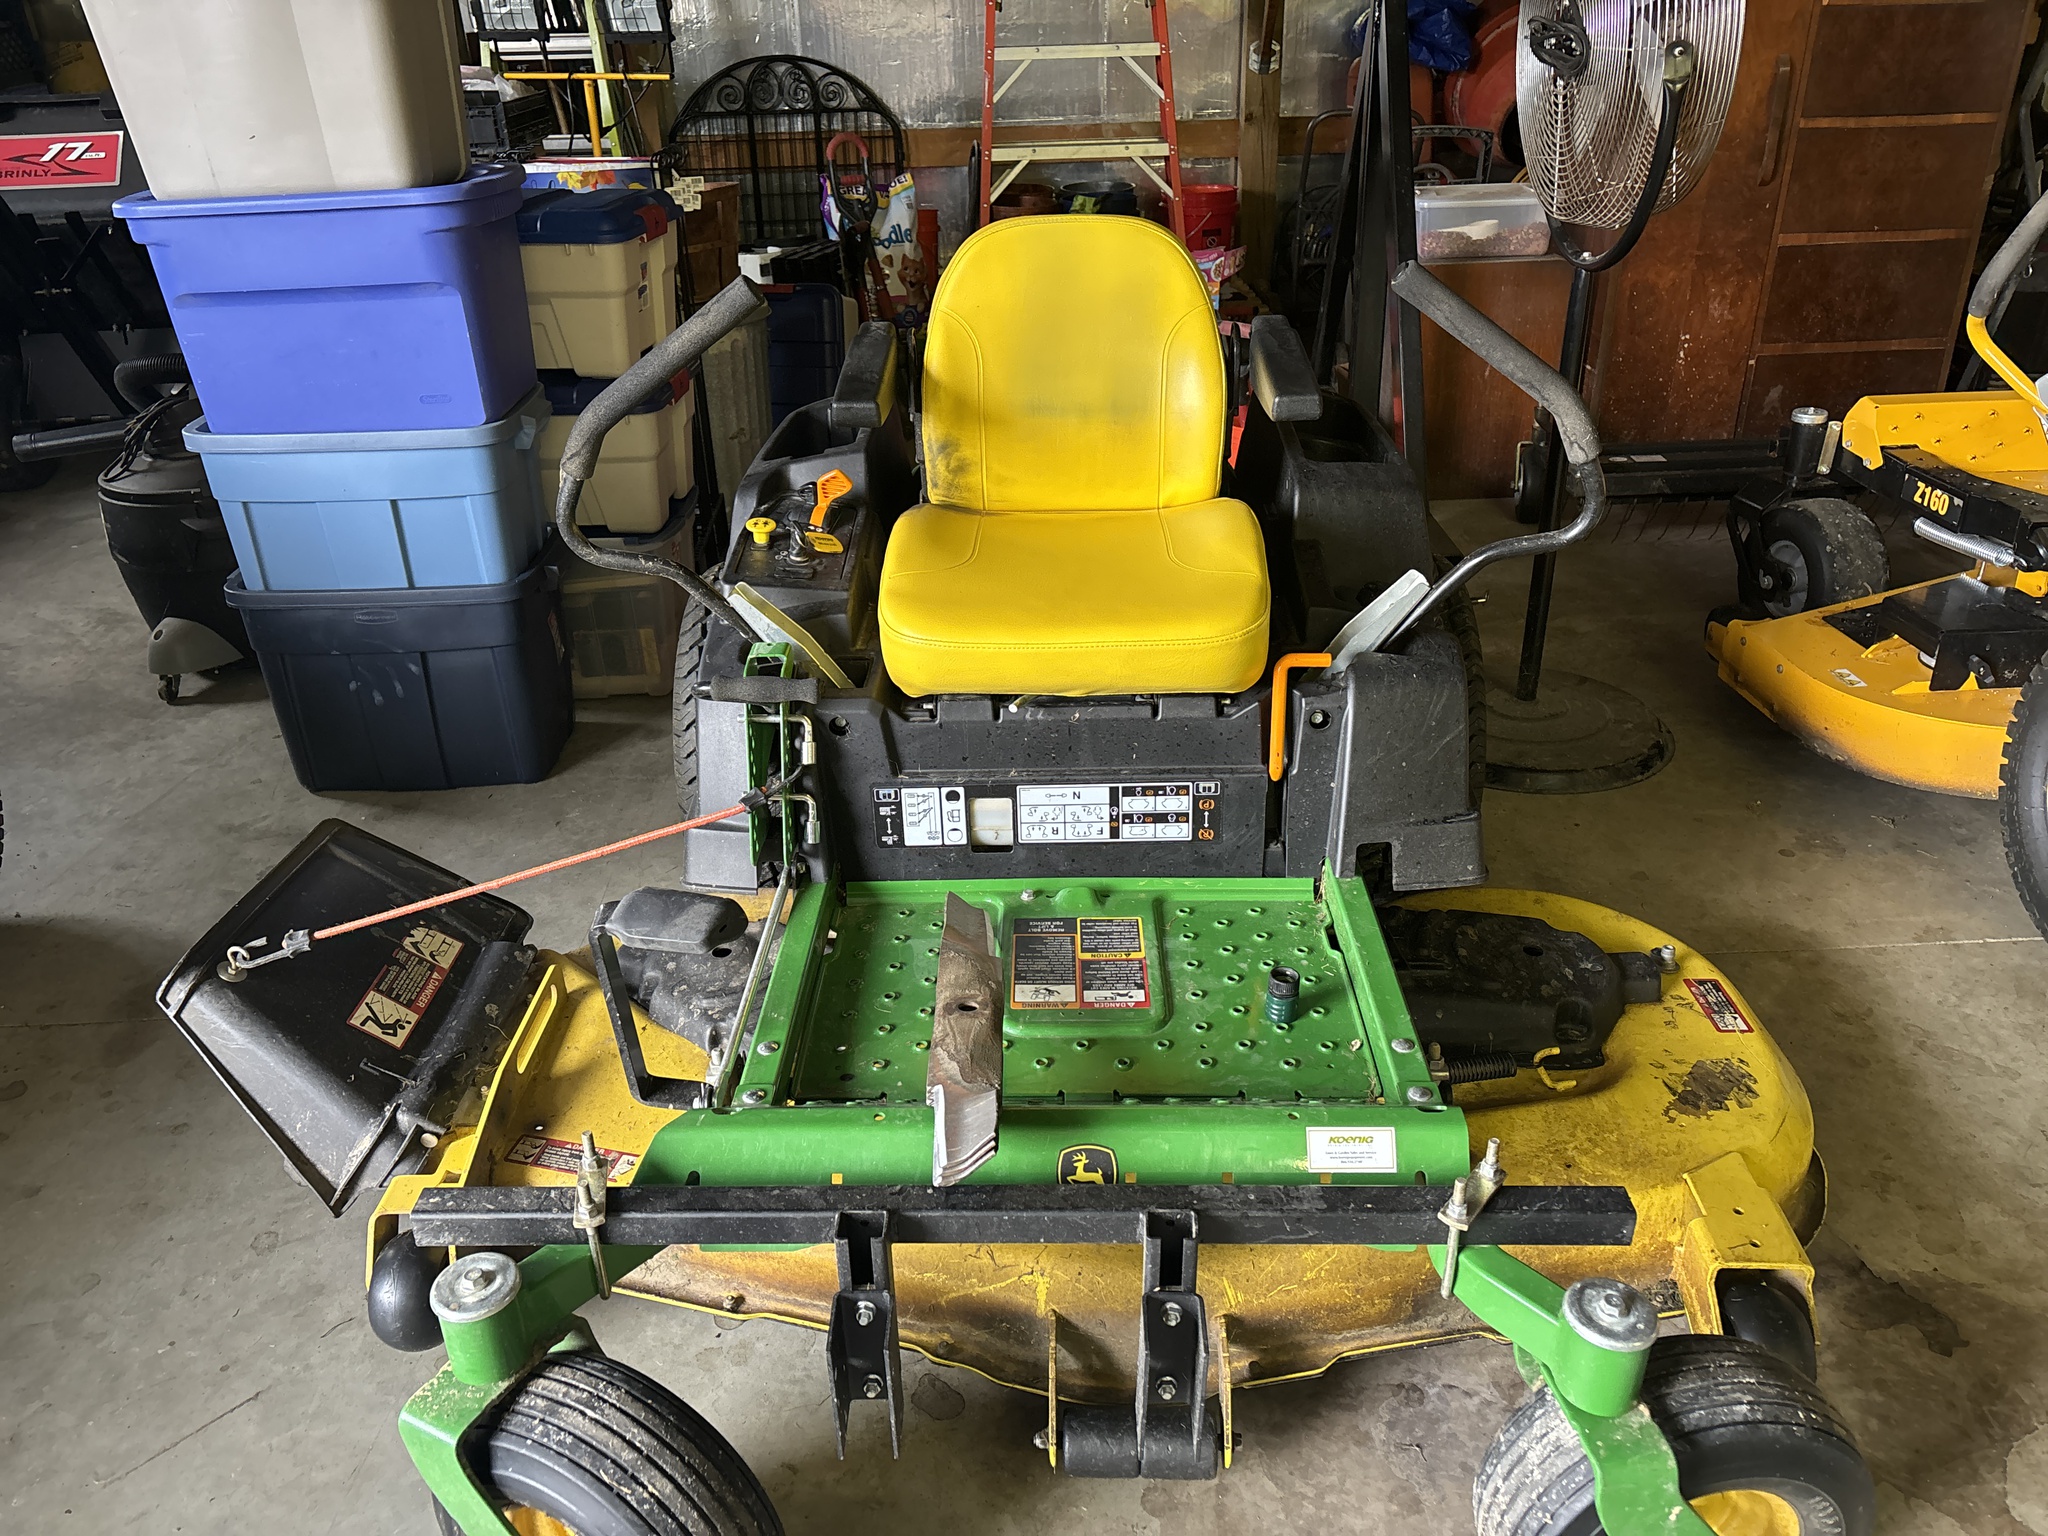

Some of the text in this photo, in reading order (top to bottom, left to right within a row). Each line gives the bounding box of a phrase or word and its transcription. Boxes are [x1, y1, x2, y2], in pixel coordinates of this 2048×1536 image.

[39, 142, 94, 162] 17
[0, 169, 51, 178] RINLY
[840, 186, 867, 196] GREA
[874, 224, 913, 249] oodle
[1914, 480, 1950, 516] Z160
[1072, 791, 1080, 800] N
[1051, 827, 1059, 835] R
[1096, 827, 1104, 835] F
[416, 980, 438, 1008] DANGER
[572, 1144, 605, 1154] DAER
